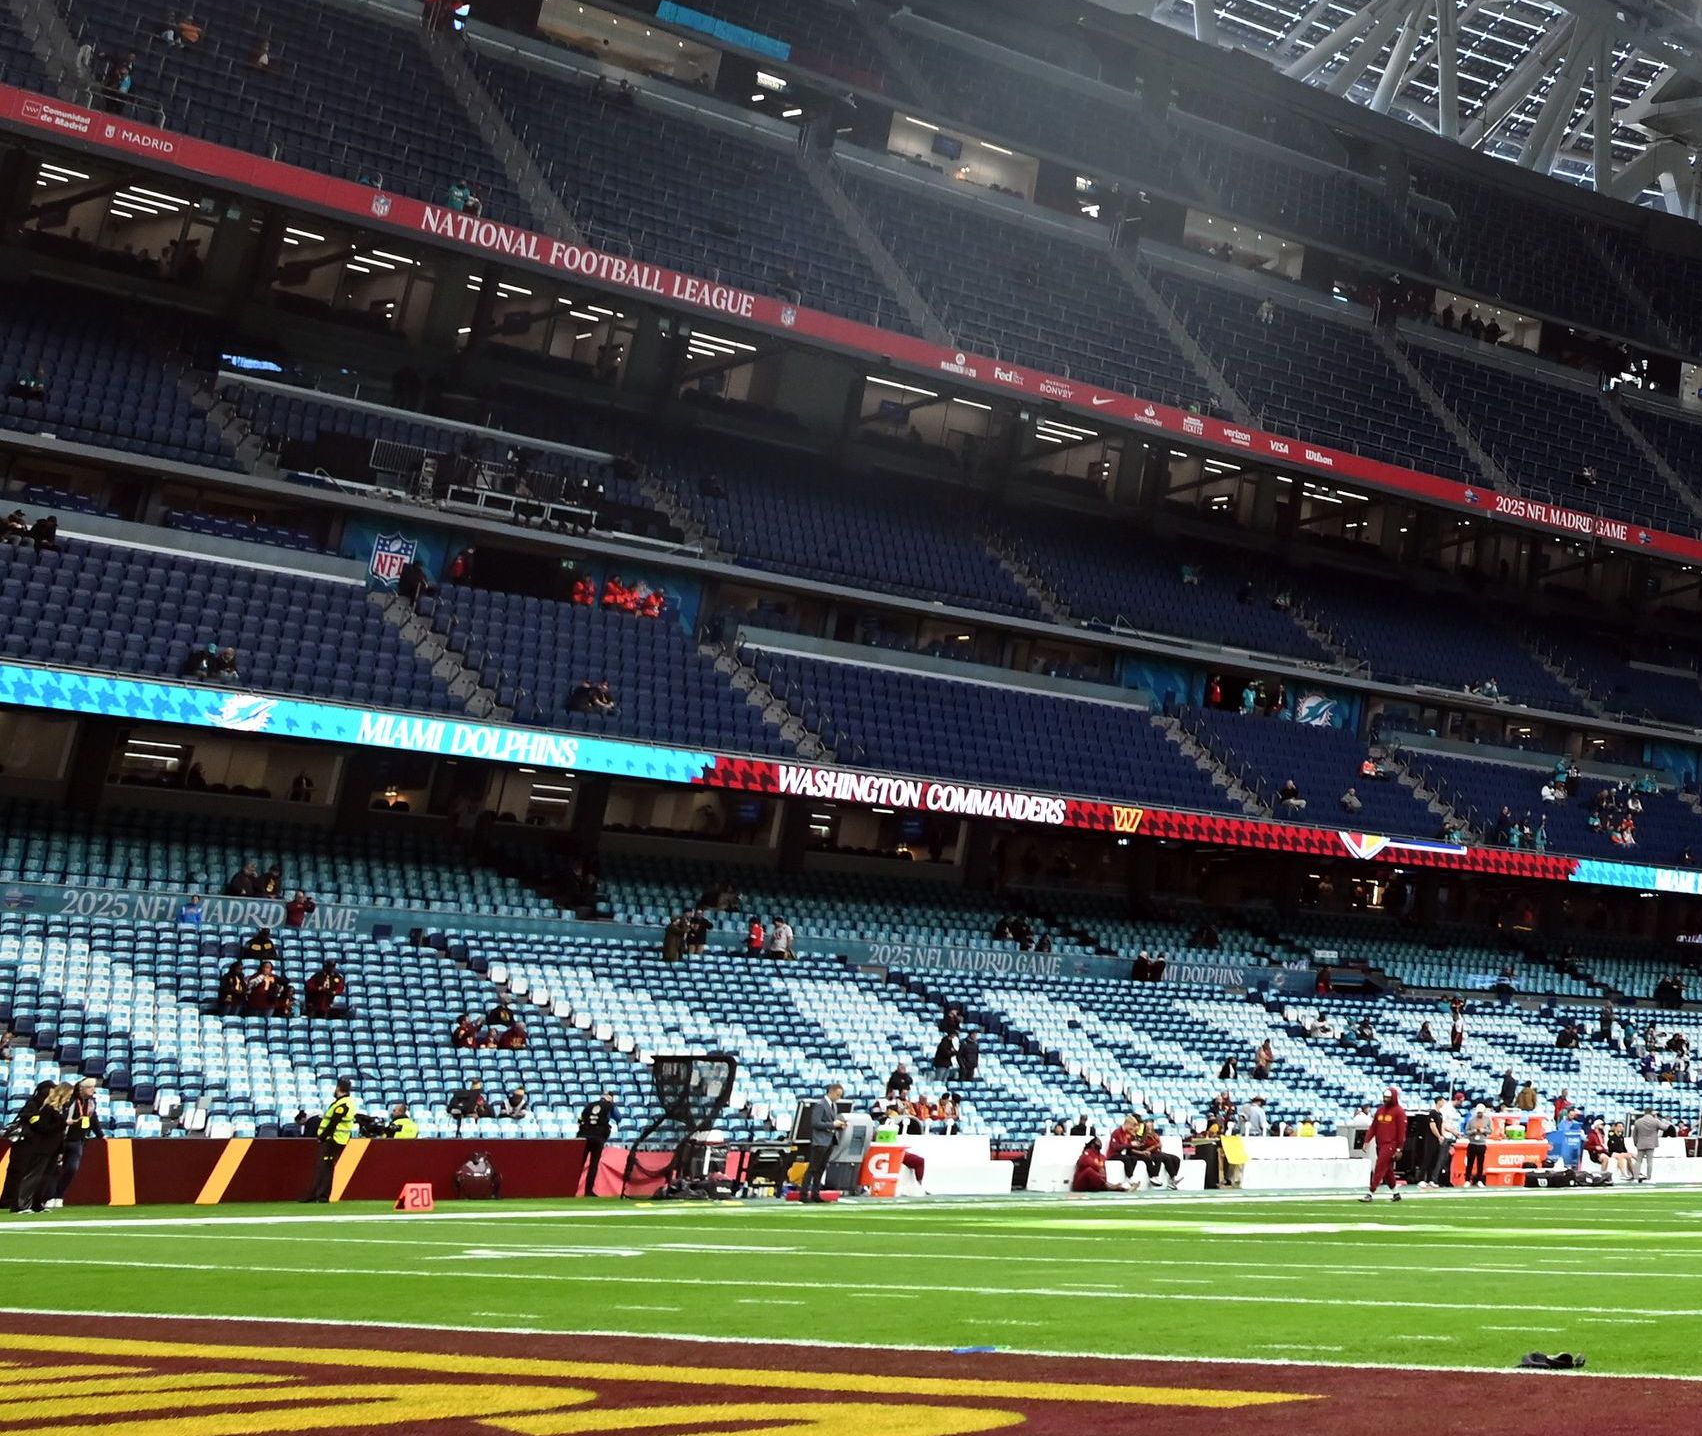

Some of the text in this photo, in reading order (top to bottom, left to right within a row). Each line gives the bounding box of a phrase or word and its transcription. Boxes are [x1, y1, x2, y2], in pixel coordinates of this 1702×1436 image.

[40, 114, 88, 133] de Madrid
[43, 105, 91, 124] Comunidad
[121, 130, 173, 153] MADRID
[420, 206, 755, 318] NATIONAL FOOTBALL LEAGUE
[994, 367, 1024, 385] FedEx
[1223, 428, 1250, 442] verizon
[1270, 440, 1289, 454] VISA
[1305, 449, 1333, 465] Wilson
[1496, 495, 1627, 541] 2025 NFL MADRID GAME
[356, 712, 579, 768] MIAMI DOLPHINS
[777, 765, 923, 808] WASHINGTON
[925, 784, 1066, 825] COMMANDERS
[61, 890, 129, 917] 2025
[133, 897, 178, 922] NFL
[301, 906, 359, 931] AME
[869, 945, 1062, 975] 2025 NFL MADRID GAME
[1181, 966, 1244, 985] DOLPHINS
[410, 1188, 430, 1207] 20
